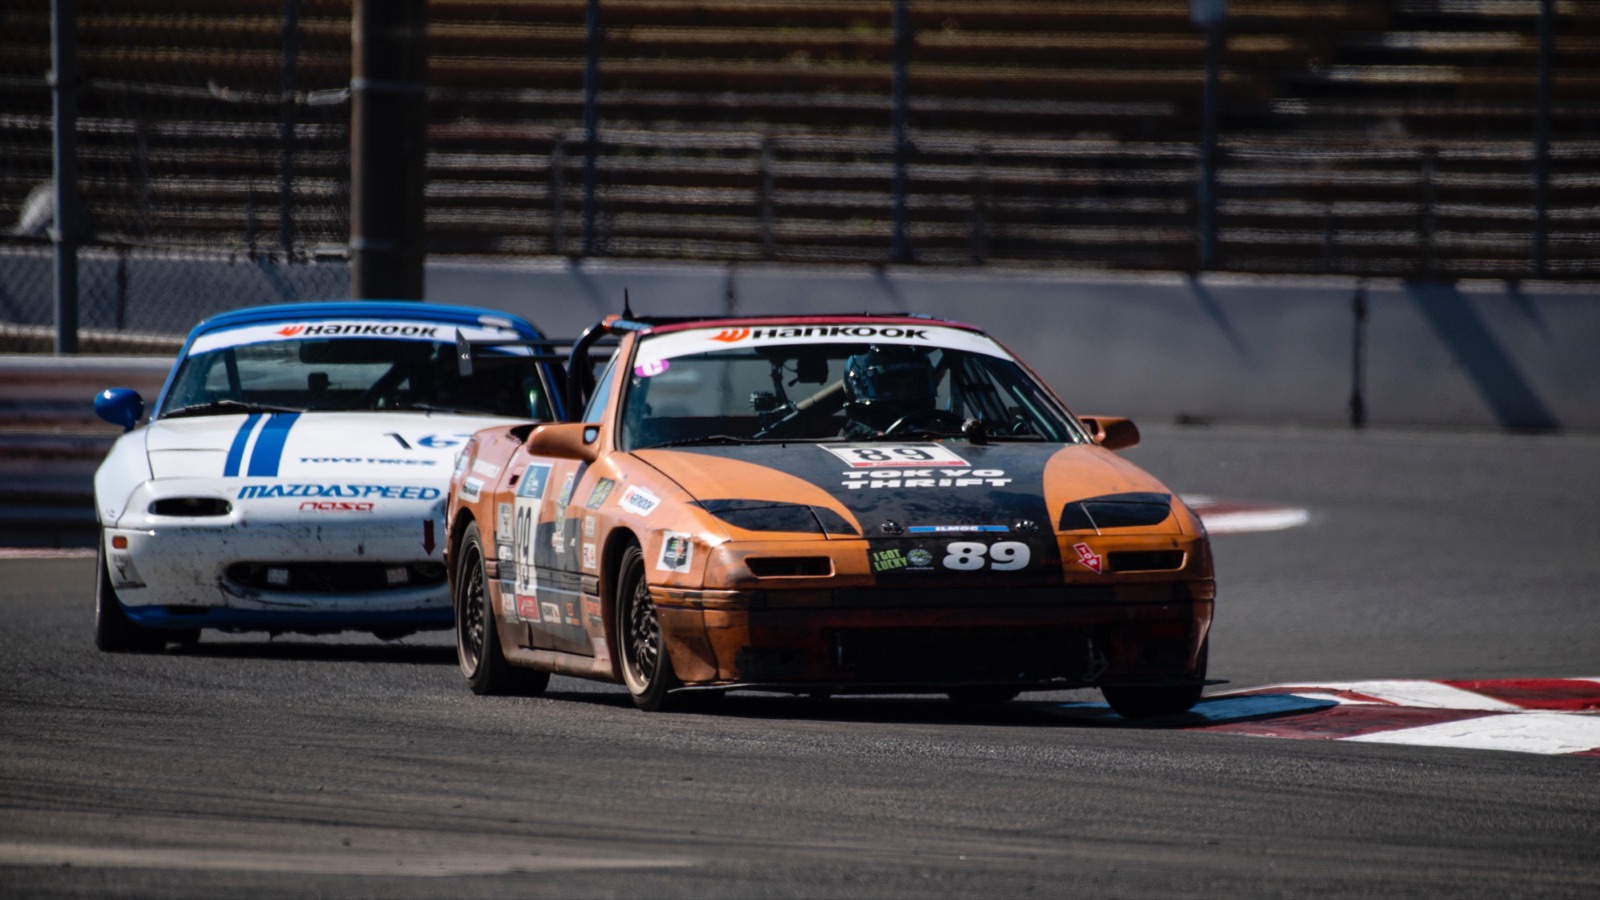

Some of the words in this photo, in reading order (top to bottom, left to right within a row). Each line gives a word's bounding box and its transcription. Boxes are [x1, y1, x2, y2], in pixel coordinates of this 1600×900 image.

[852, 448, 934, 461] 89
[842, 469, 1005, 479] TOKYO
[841, 478, 1012, 490] THRIFT
[237, 484, 441, 500] MAZDASPEED
[872, 552, 880, 561] I
[880, 549, 901, 560] GOT
[943, 541, 1030, 571] 89
[1079, 546, 1098, 567] TOW
[873, 557, 908, 571] LUCKY
